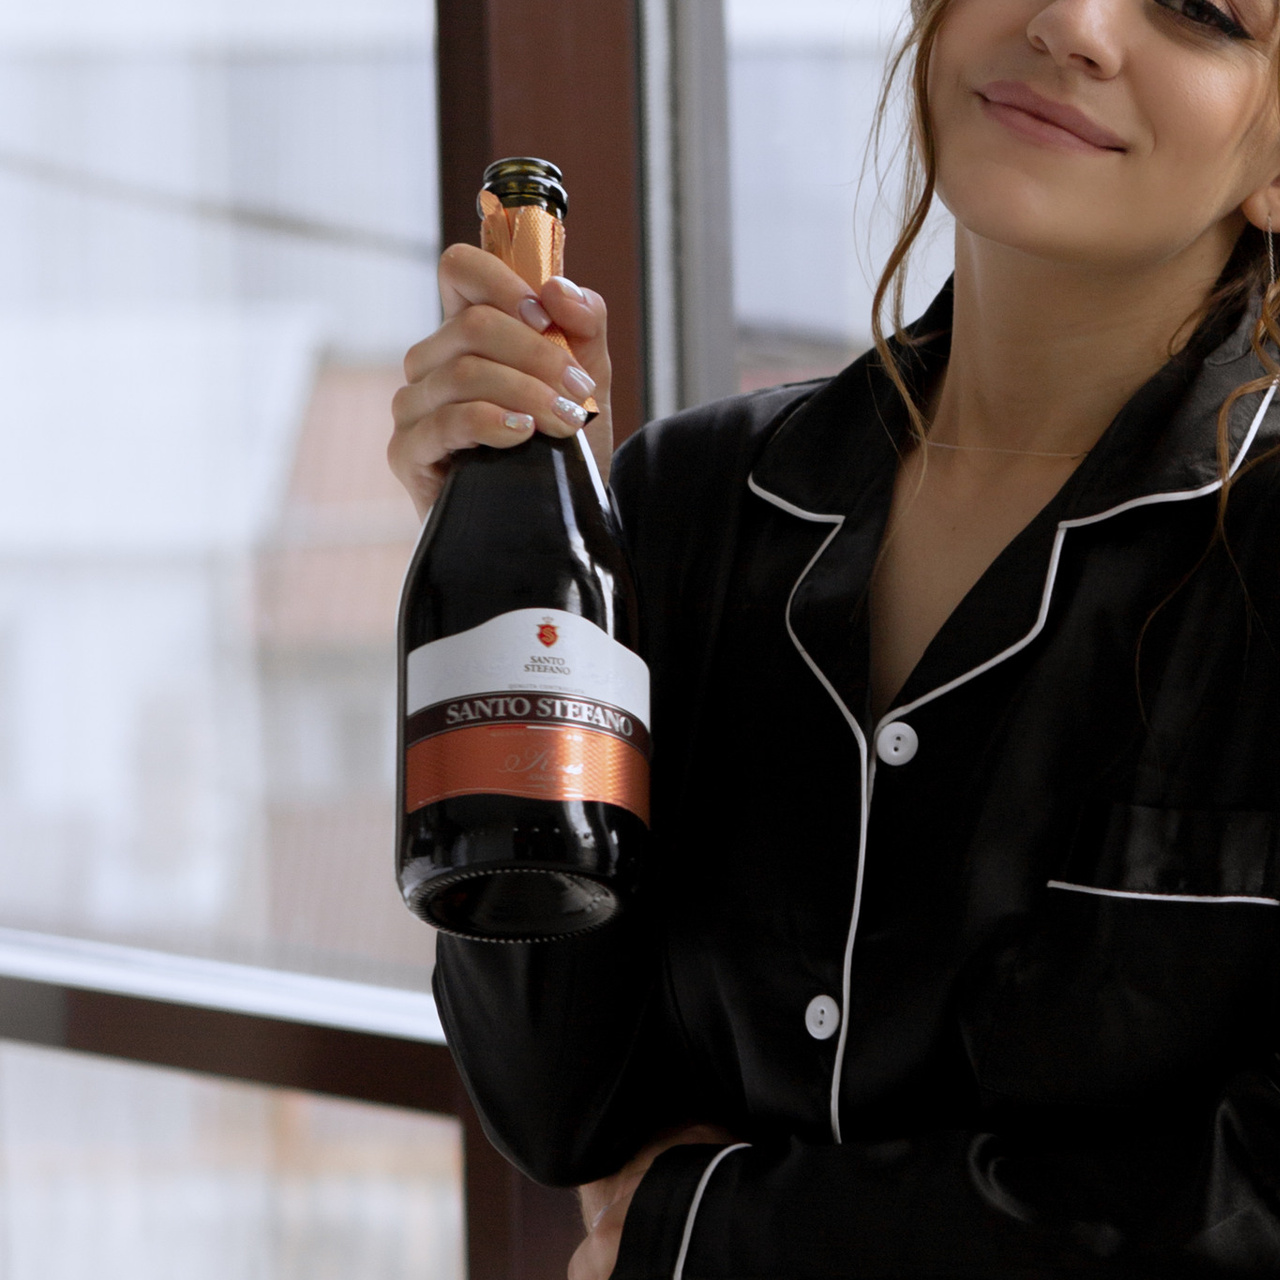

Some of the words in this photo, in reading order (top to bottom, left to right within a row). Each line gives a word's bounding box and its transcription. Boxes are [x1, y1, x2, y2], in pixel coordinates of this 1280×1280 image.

[530, 655, 565, 666] SANTO
[524, 663, 571, 676] STEFANO
[446, 696, 531, 724] SANTO
[536, 697, 633, 737] STEFANO
